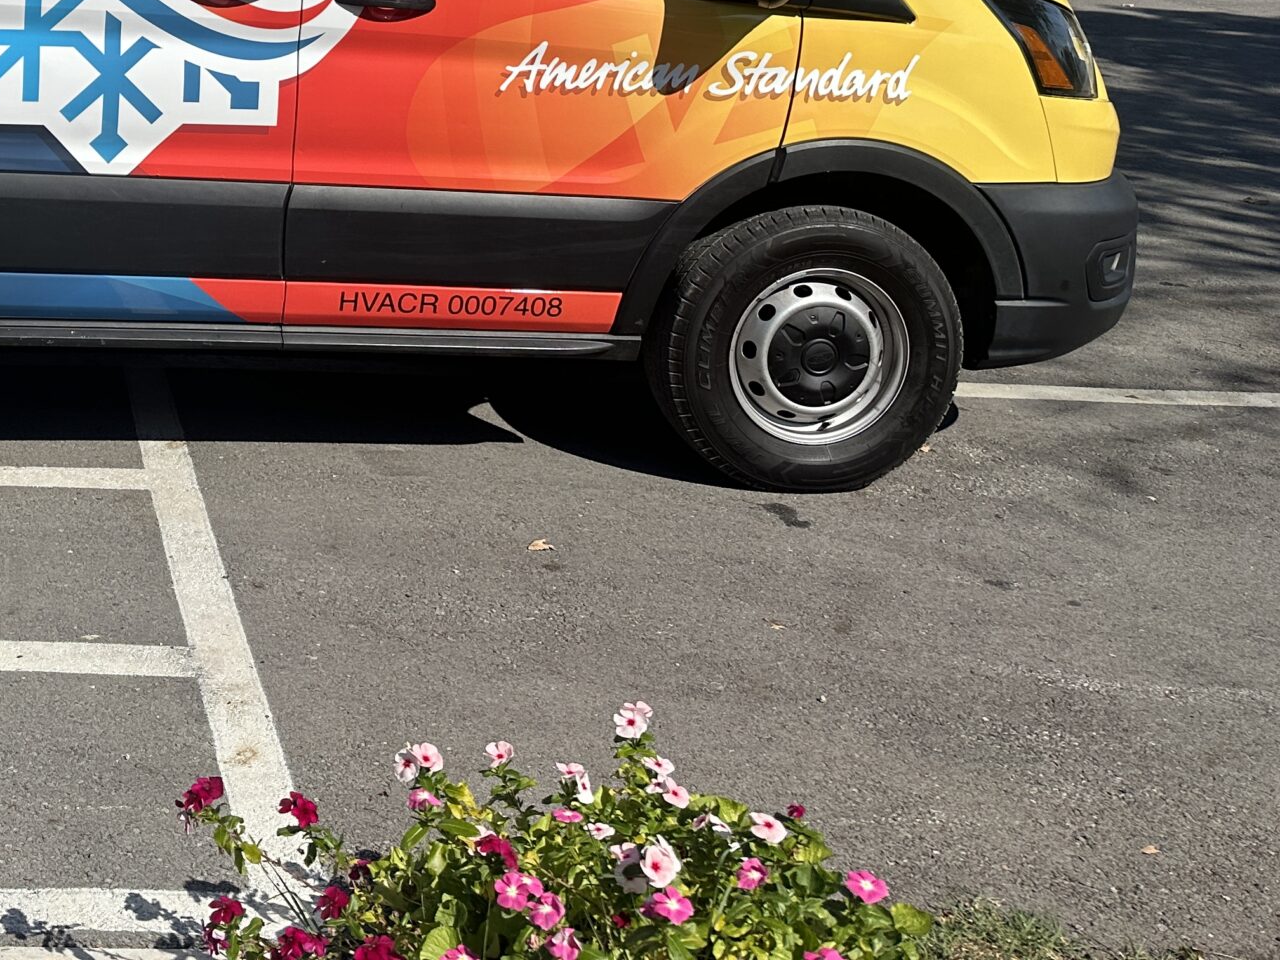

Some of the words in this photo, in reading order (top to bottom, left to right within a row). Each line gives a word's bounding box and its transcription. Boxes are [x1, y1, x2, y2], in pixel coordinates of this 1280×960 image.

[498, 39, 700, 95] American
[708, 50, 920, 99] Standard
[338, 291, 440, 315] HVACR
[447, 294, 564, 318] 0007408
